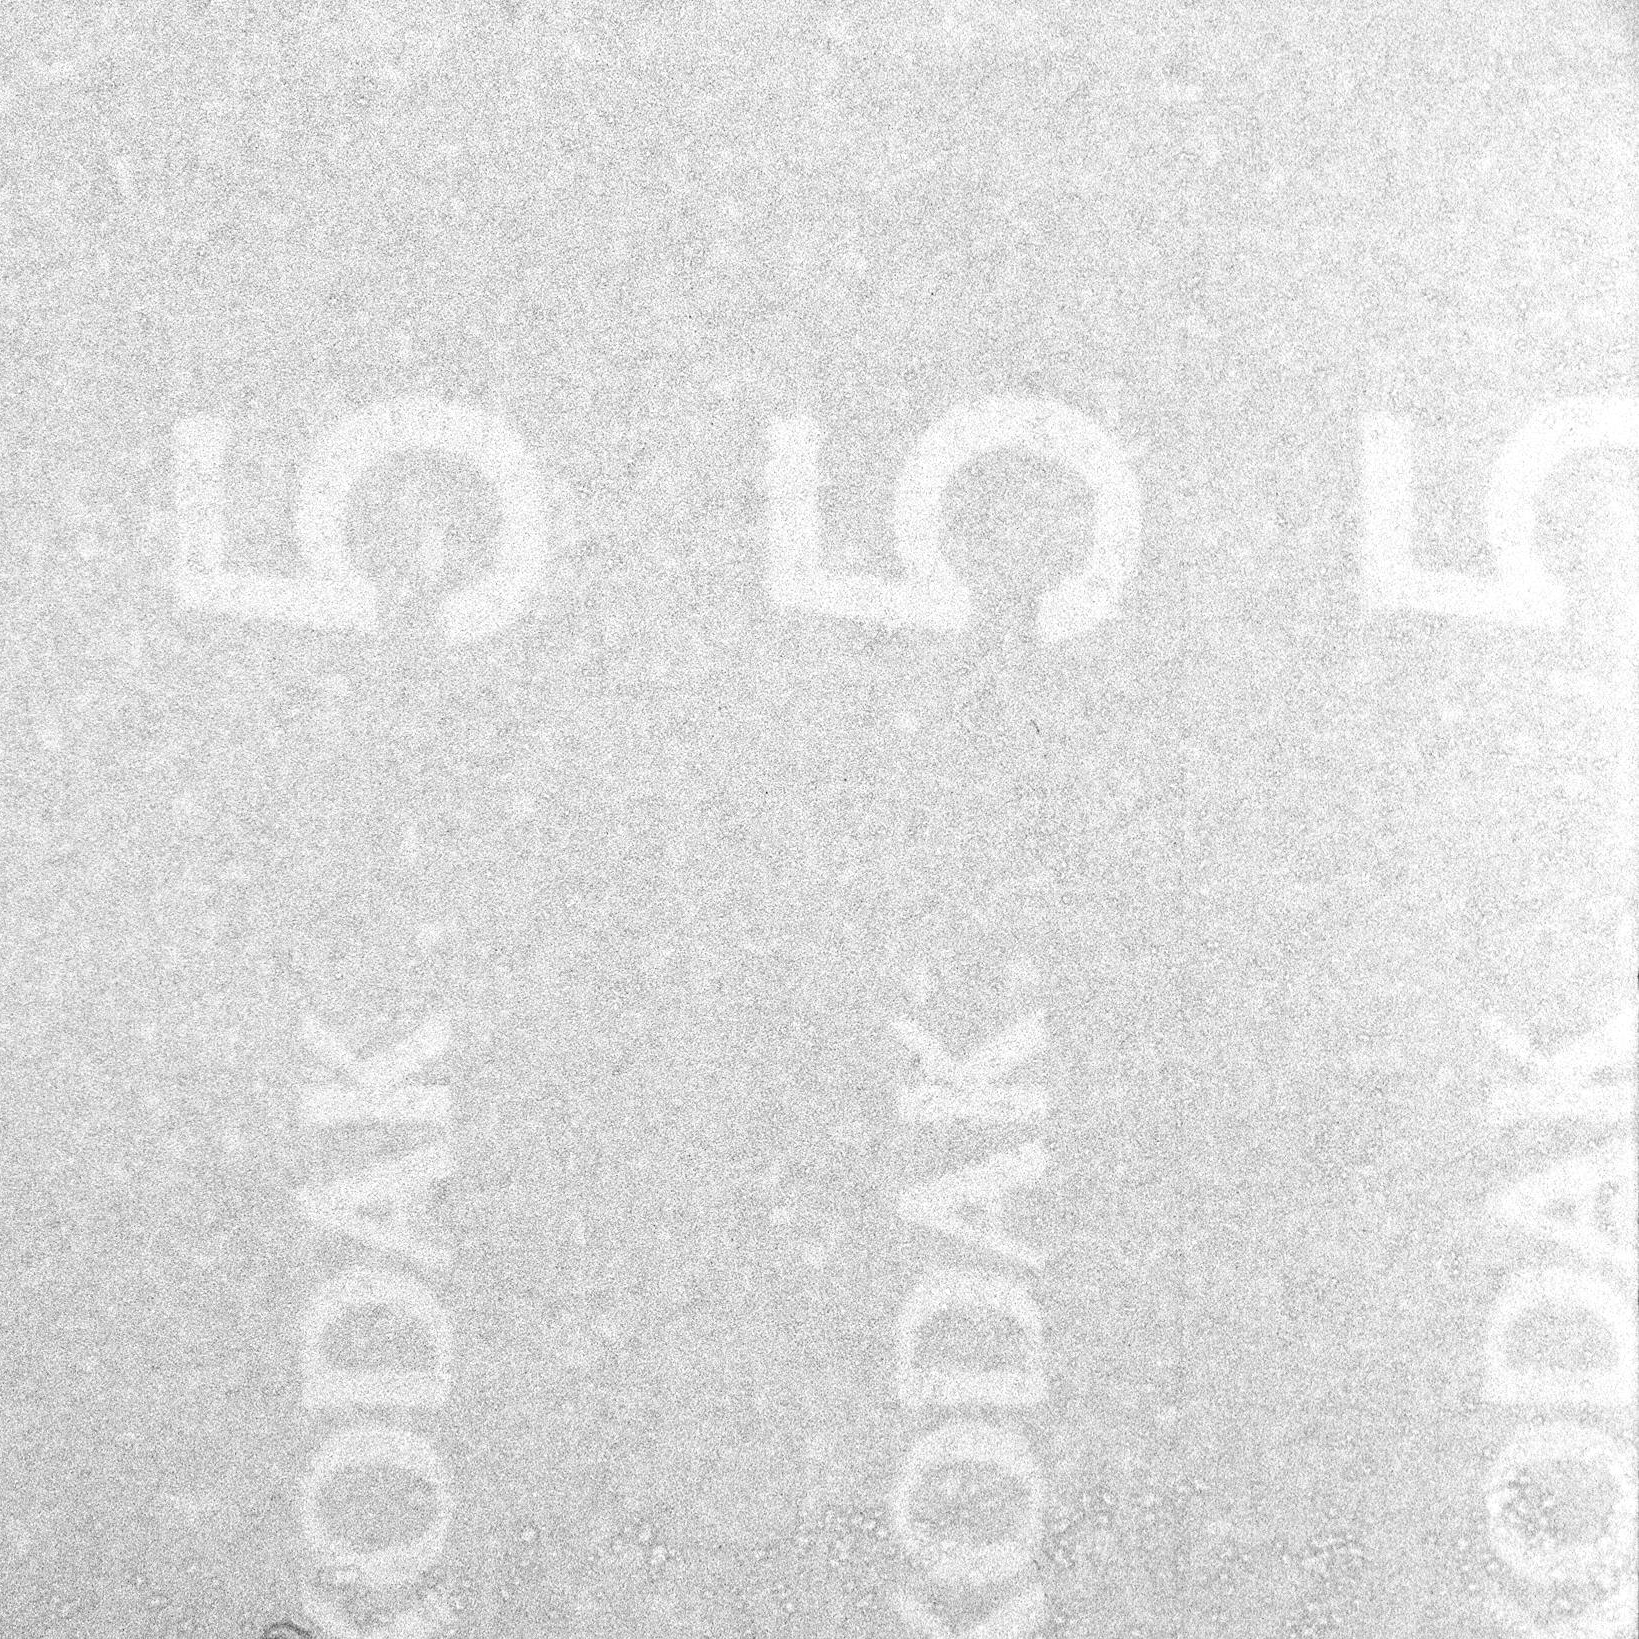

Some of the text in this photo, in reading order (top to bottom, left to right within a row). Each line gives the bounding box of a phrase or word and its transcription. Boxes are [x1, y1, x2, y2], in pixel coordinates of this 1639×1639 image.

[173, 395, 551, 645] 5
[766, 395, 1143, 645] 5
[1361, 393, 1637, 632] 5
